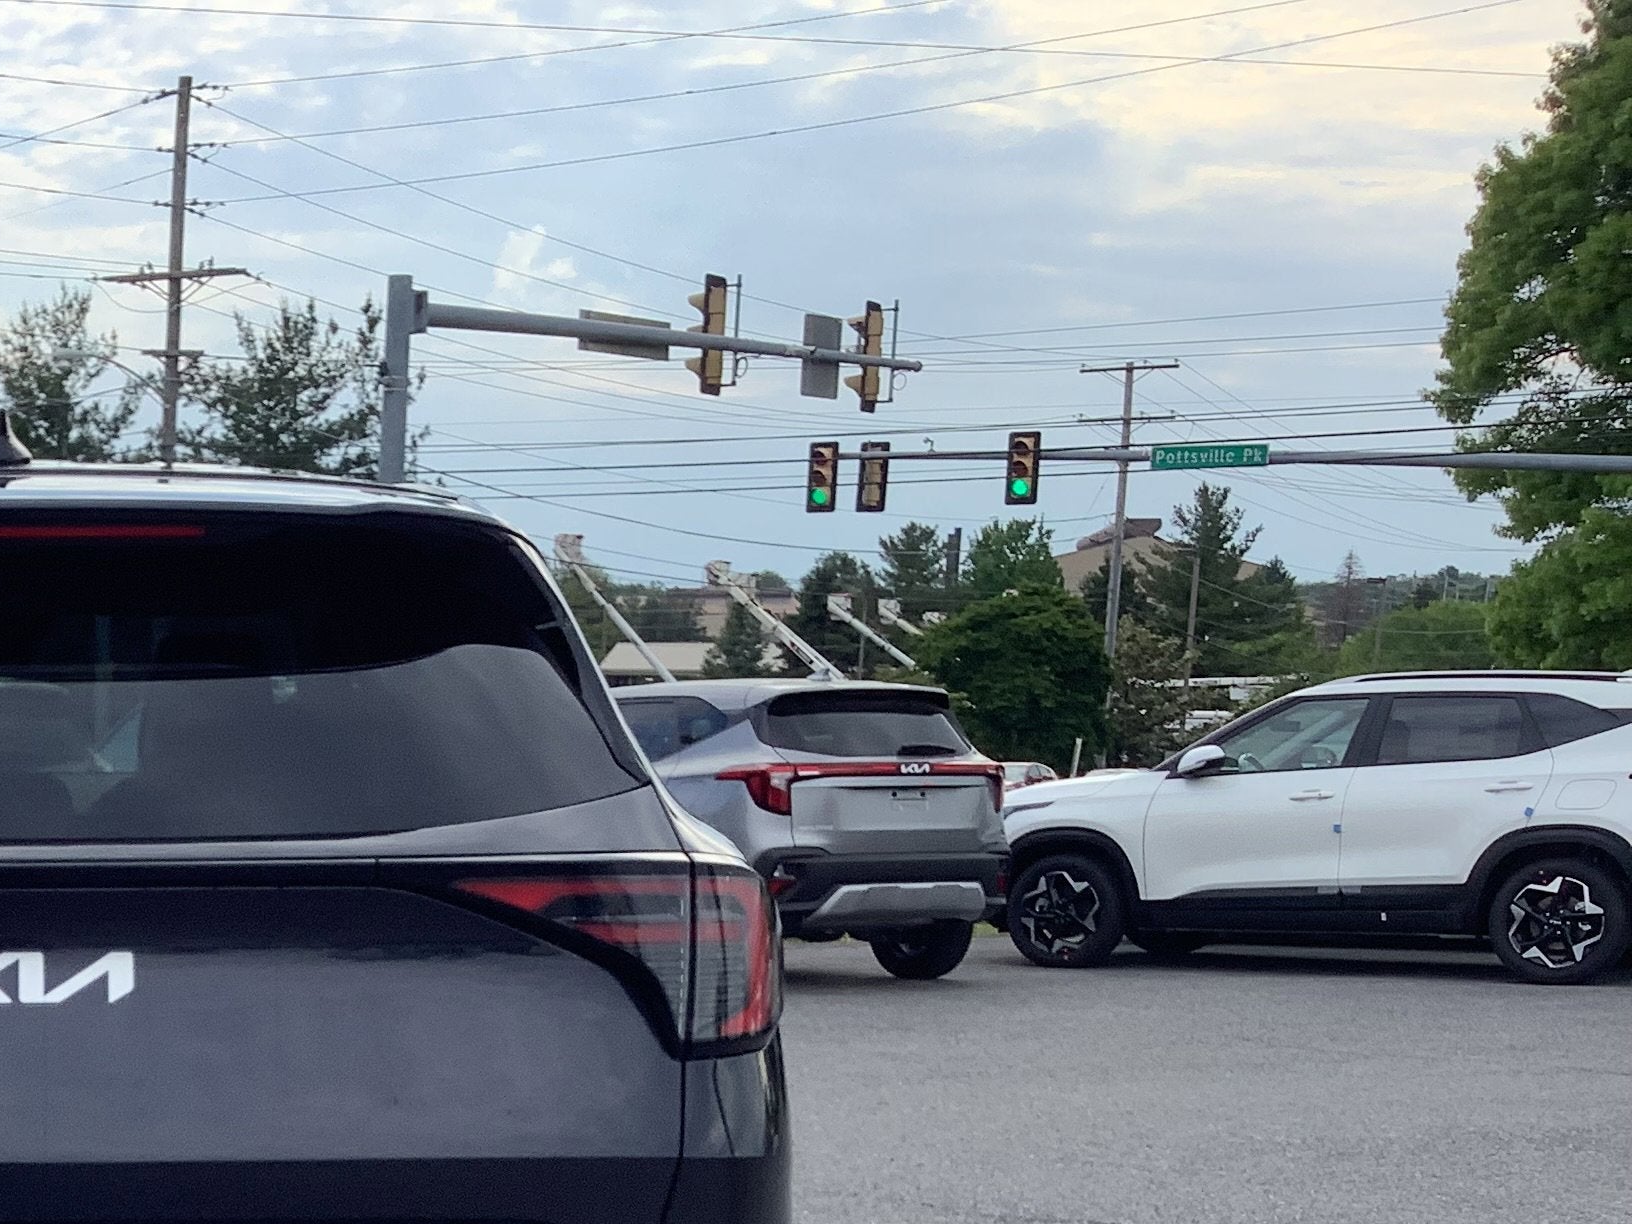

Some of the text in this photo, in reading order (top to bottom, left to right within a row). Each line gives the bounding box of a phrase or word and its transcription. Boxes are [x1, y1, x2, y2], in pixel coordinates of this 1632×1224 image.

[1155, 448, 1262, 464] Pottsville Pk
[900, 763, 930, 774] KIA
